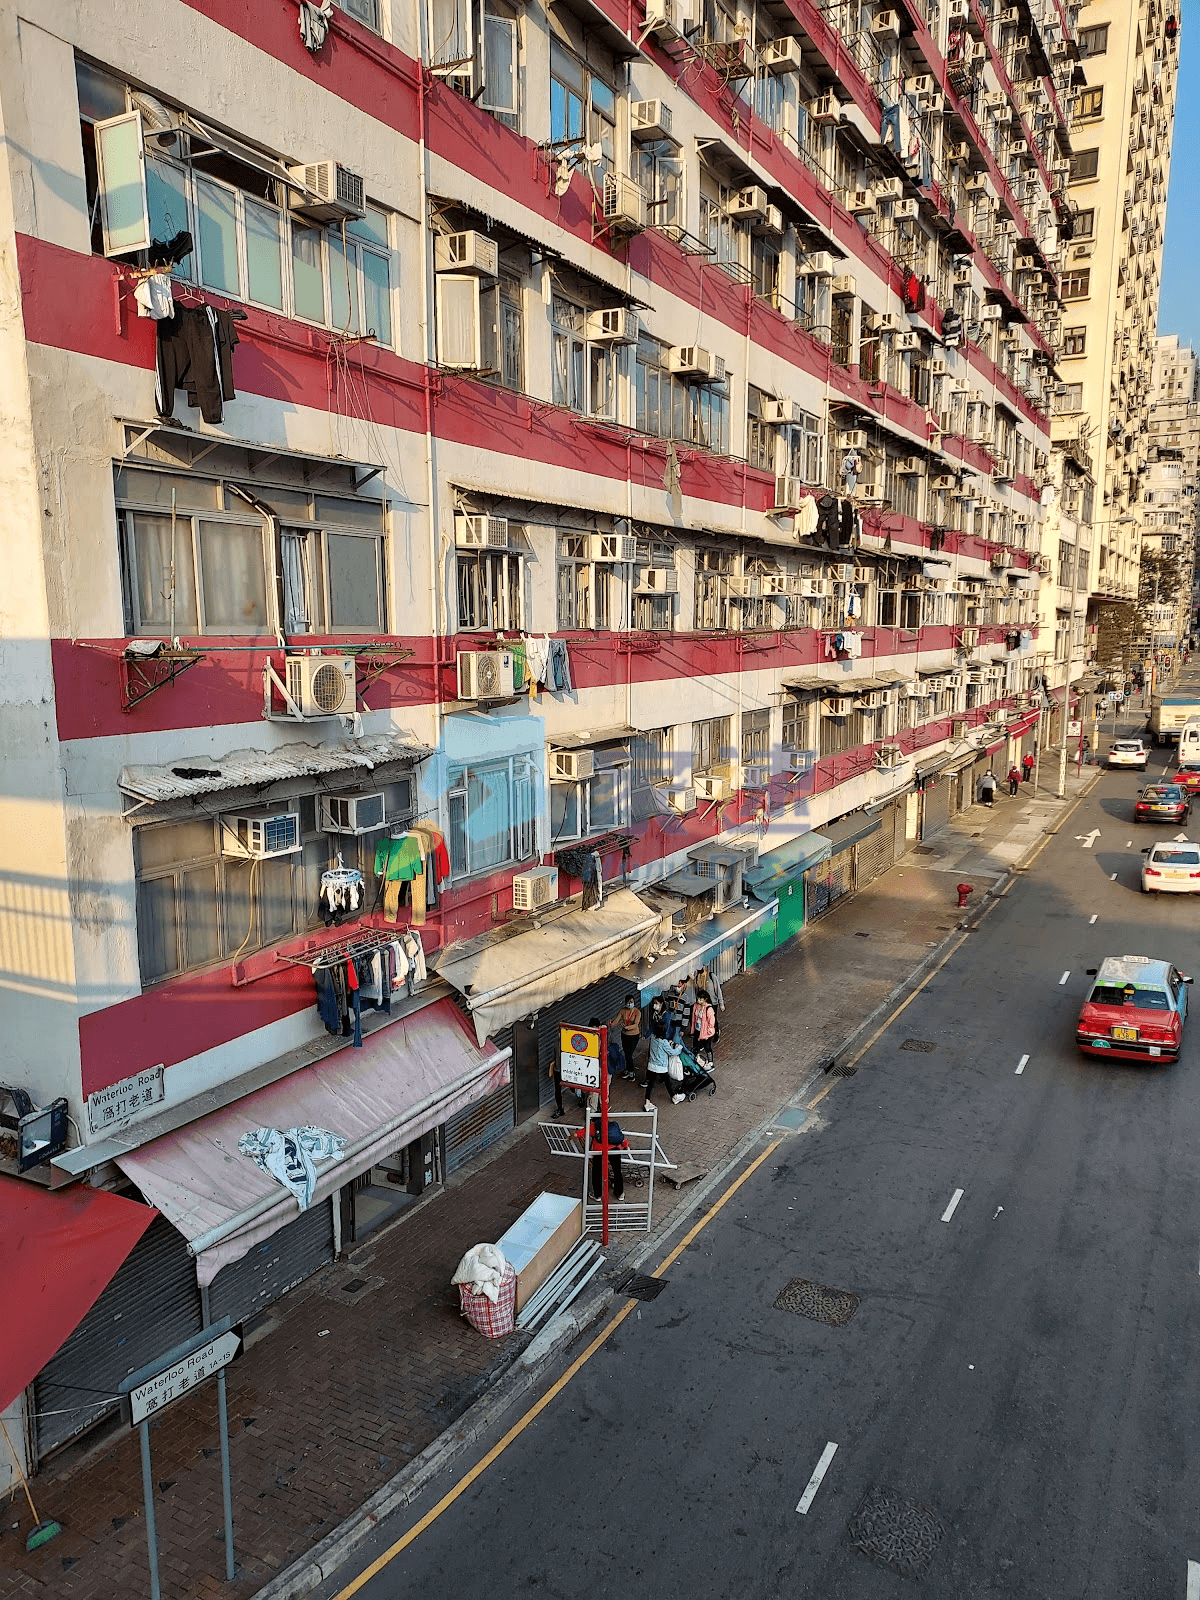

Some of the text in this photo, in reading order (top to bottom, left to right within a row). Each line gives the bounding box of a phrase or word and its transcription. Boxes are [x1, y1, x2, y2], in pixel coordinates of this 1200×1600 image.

[584, 1059, 590, 1068] 7
[92, 1071, 160, 1107] Waterloo Road
[586, 1074, 596, 1085] 12
[134, 1346, 214, 1401] Waterloo Road
